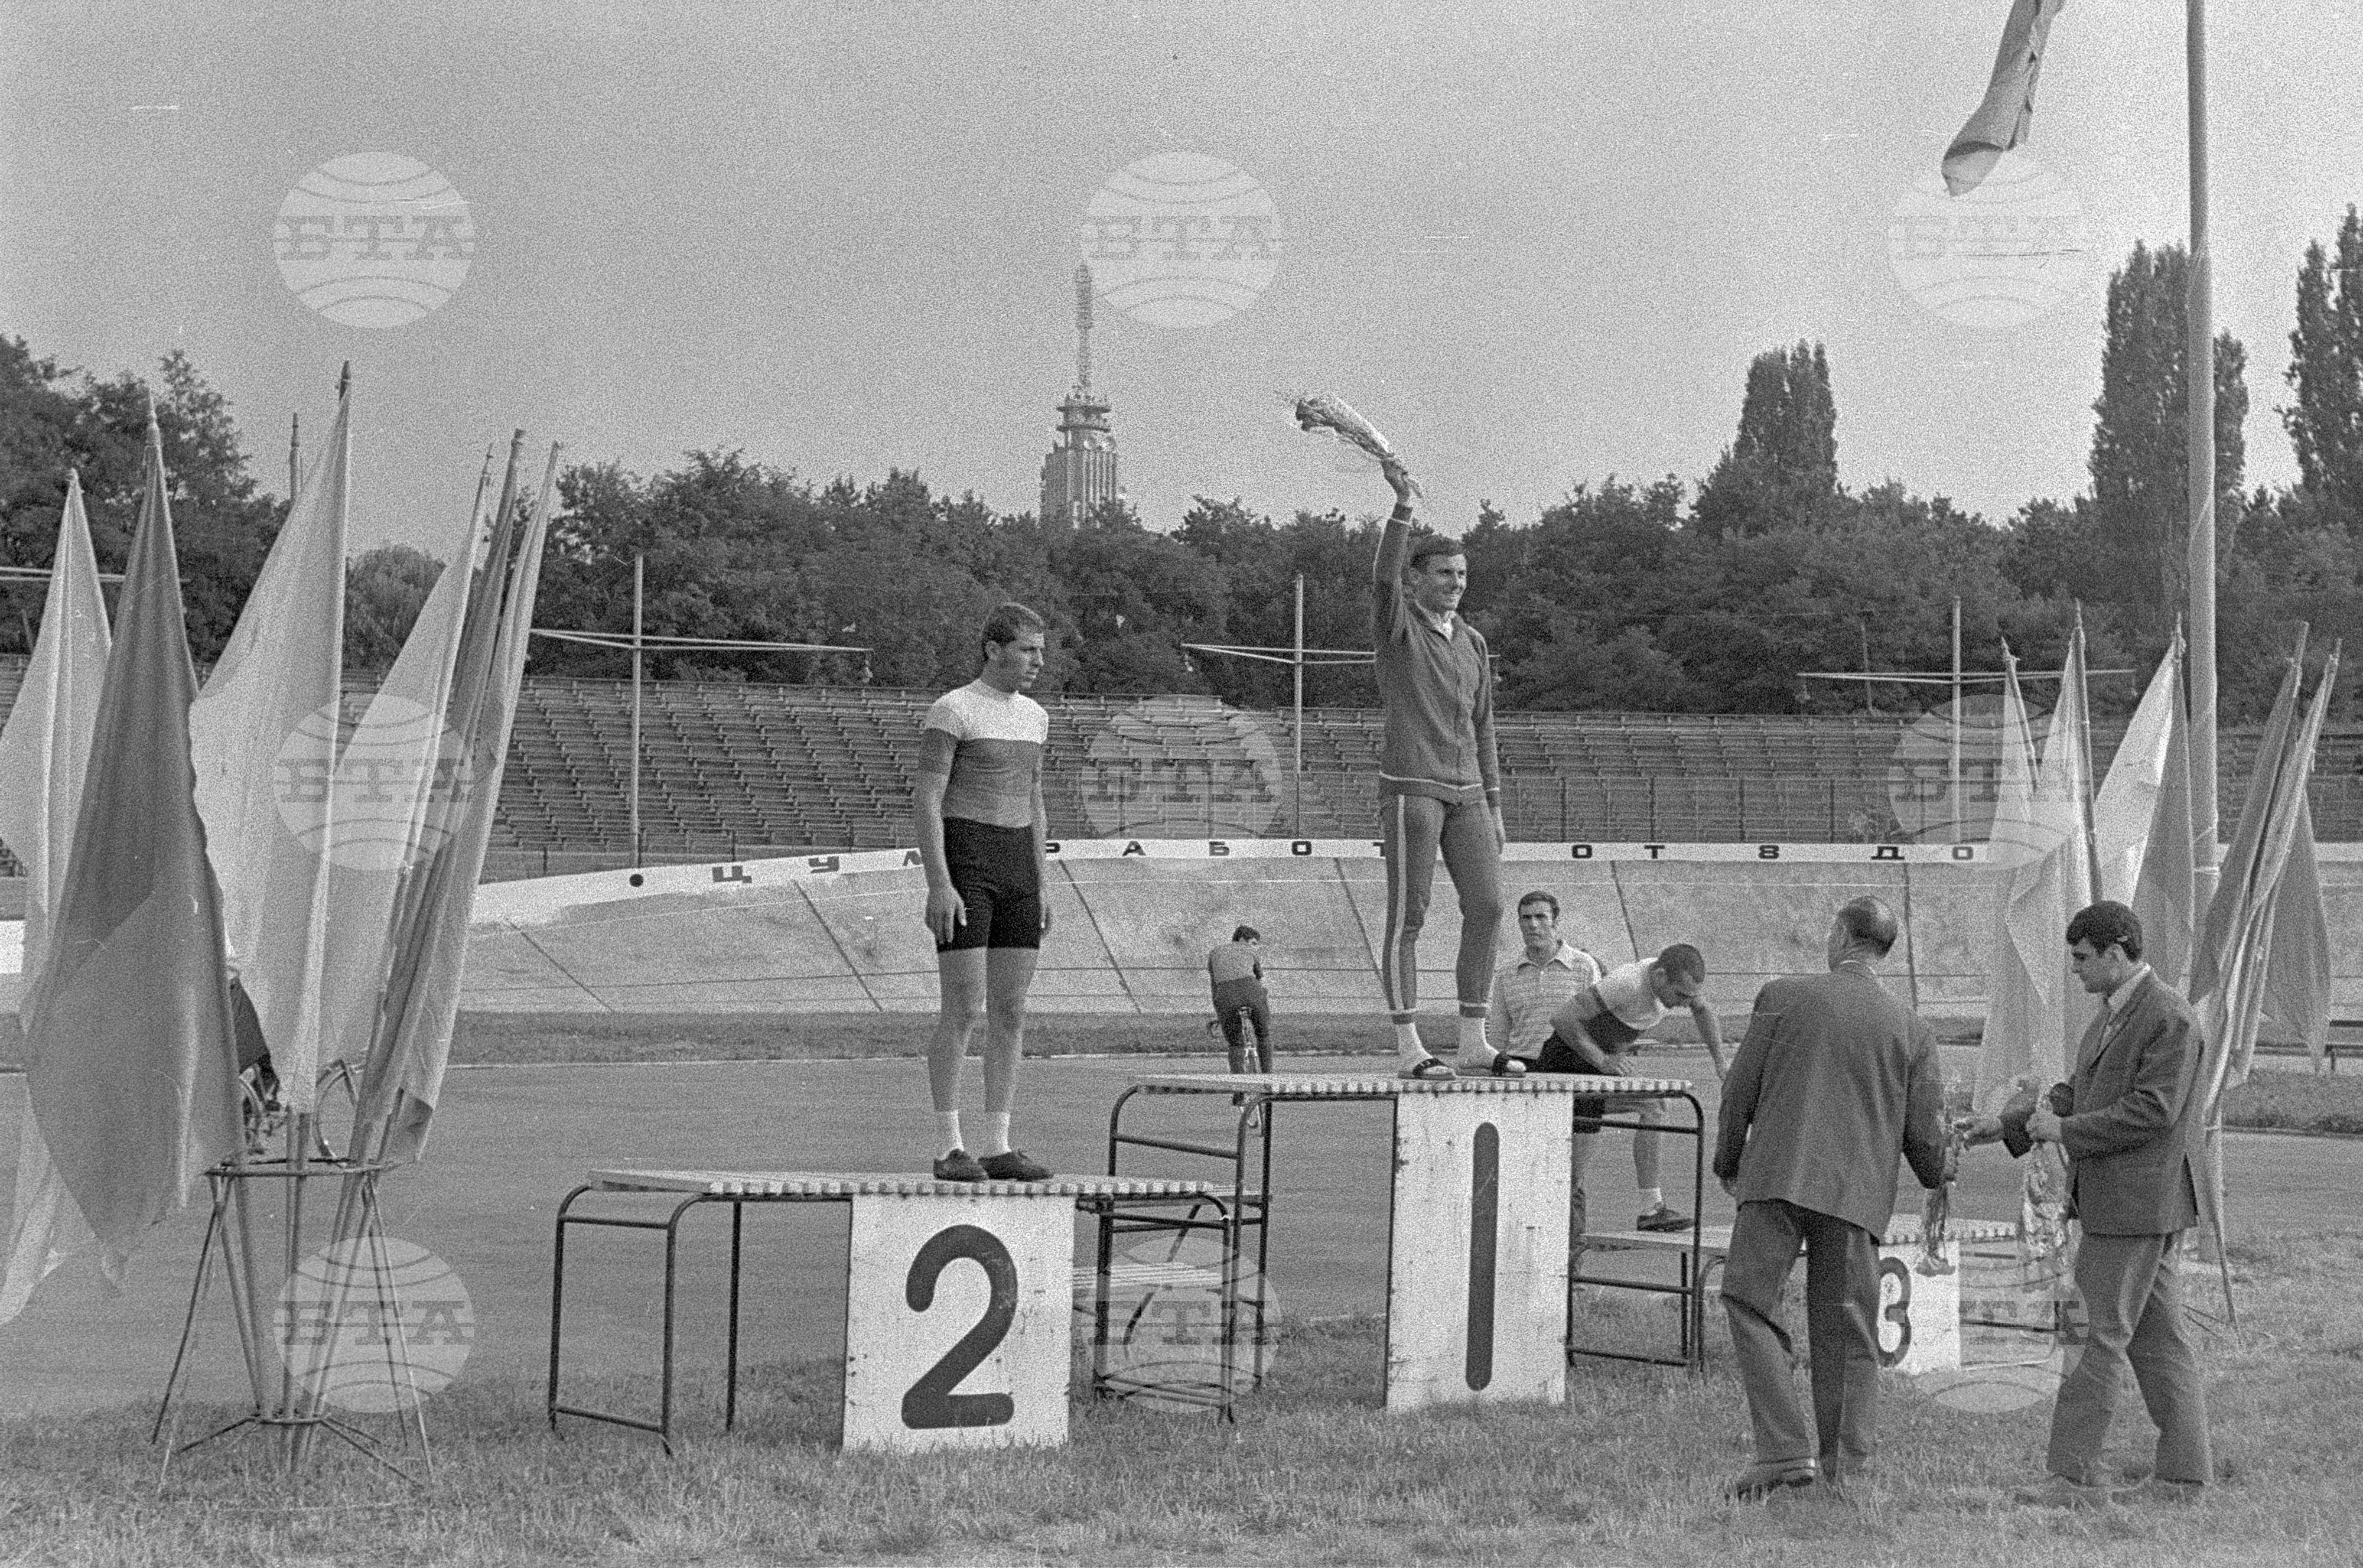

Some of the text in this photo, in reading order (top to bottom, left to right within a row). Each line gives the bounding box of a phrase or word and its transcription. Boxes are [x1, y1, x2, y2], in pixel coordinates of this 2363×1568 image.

[1571, 844, 1665, 859] ОТ
[1758, 845, 1779, 859] 8
[1871, 846, 1974, 860] ДО
[901, 1224, 1018, 1430] 2
[1466, 1122, 1499, 1391] 1
[1878, 1257, 1912, 1368] 3
